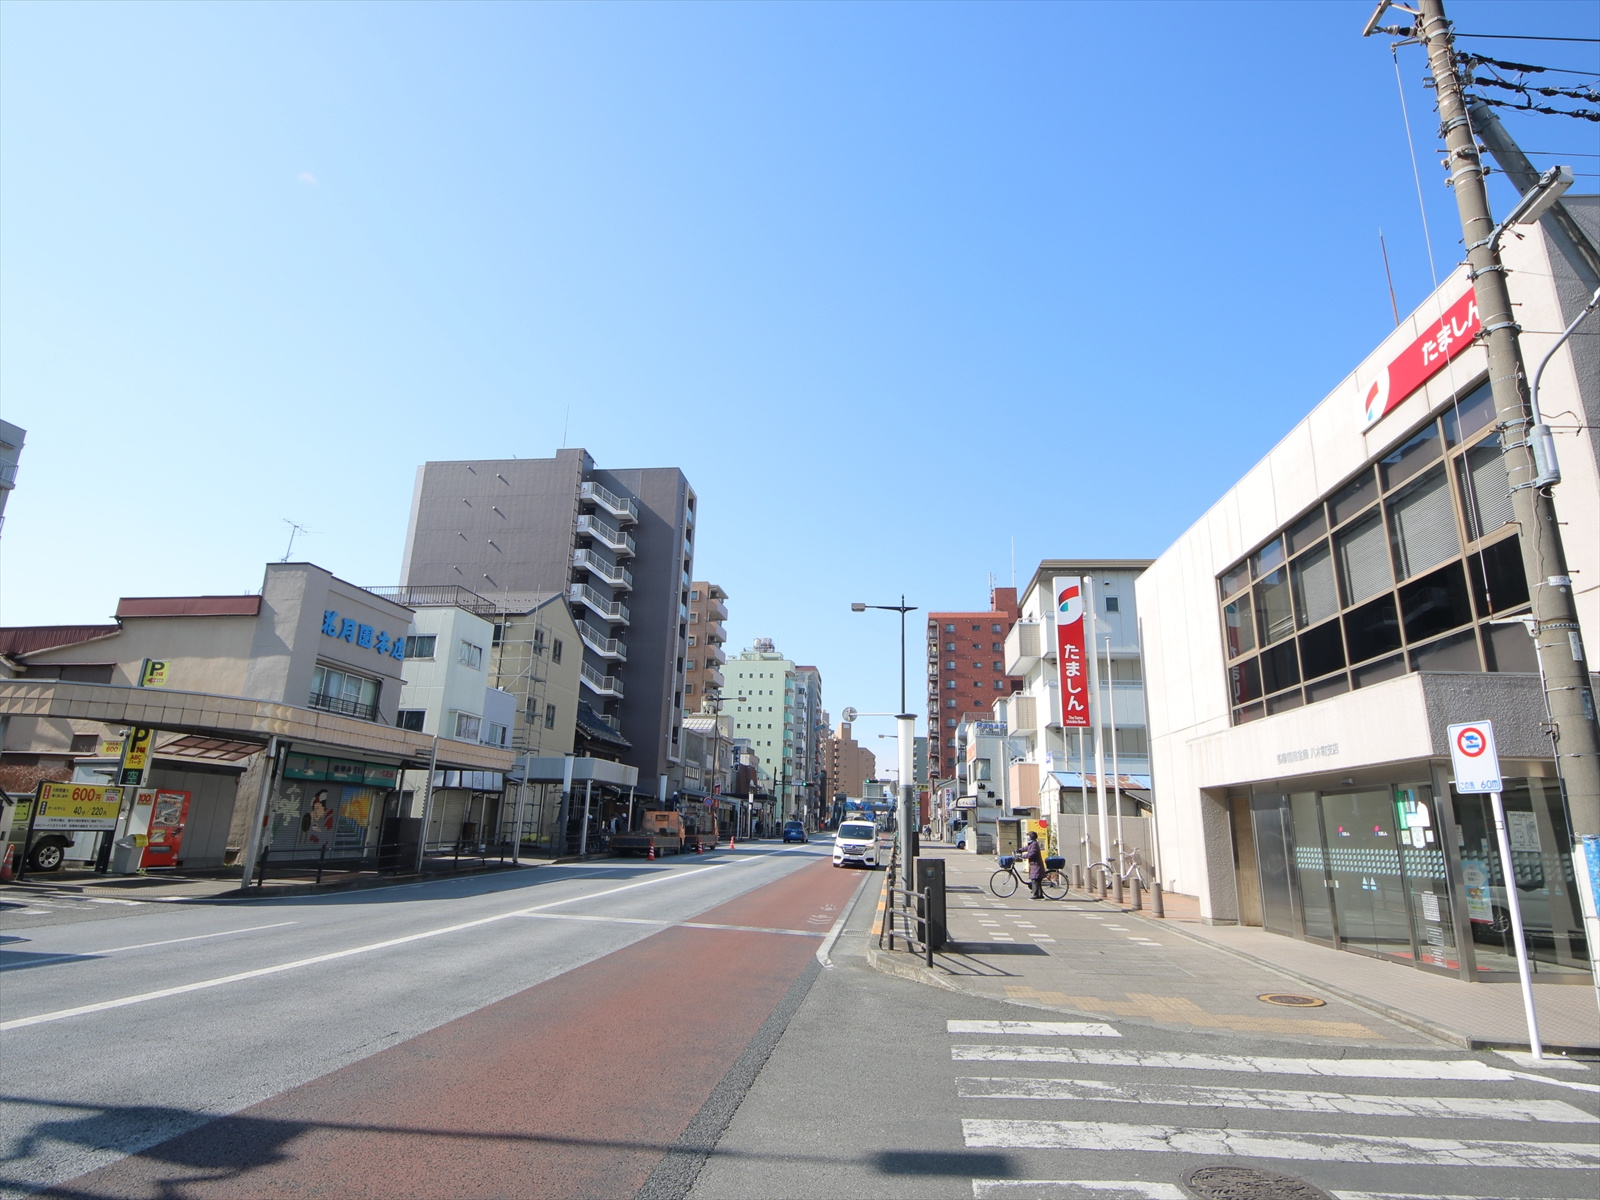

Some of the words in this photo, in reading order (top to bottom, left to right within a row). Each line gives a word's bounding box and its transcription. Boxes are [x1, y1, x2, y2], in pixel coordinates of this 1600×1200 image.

[321, 610, 405, 661] 花月園本店
[149, 661, 165, 676] P
[1064, 644, 1084, 711] たましん
[130, 727, 150, 752] P
[126, 771, 138, 784] 空
[1481, 780, 1498, 789] 60m
[72, 787, 101, 801] 600円
